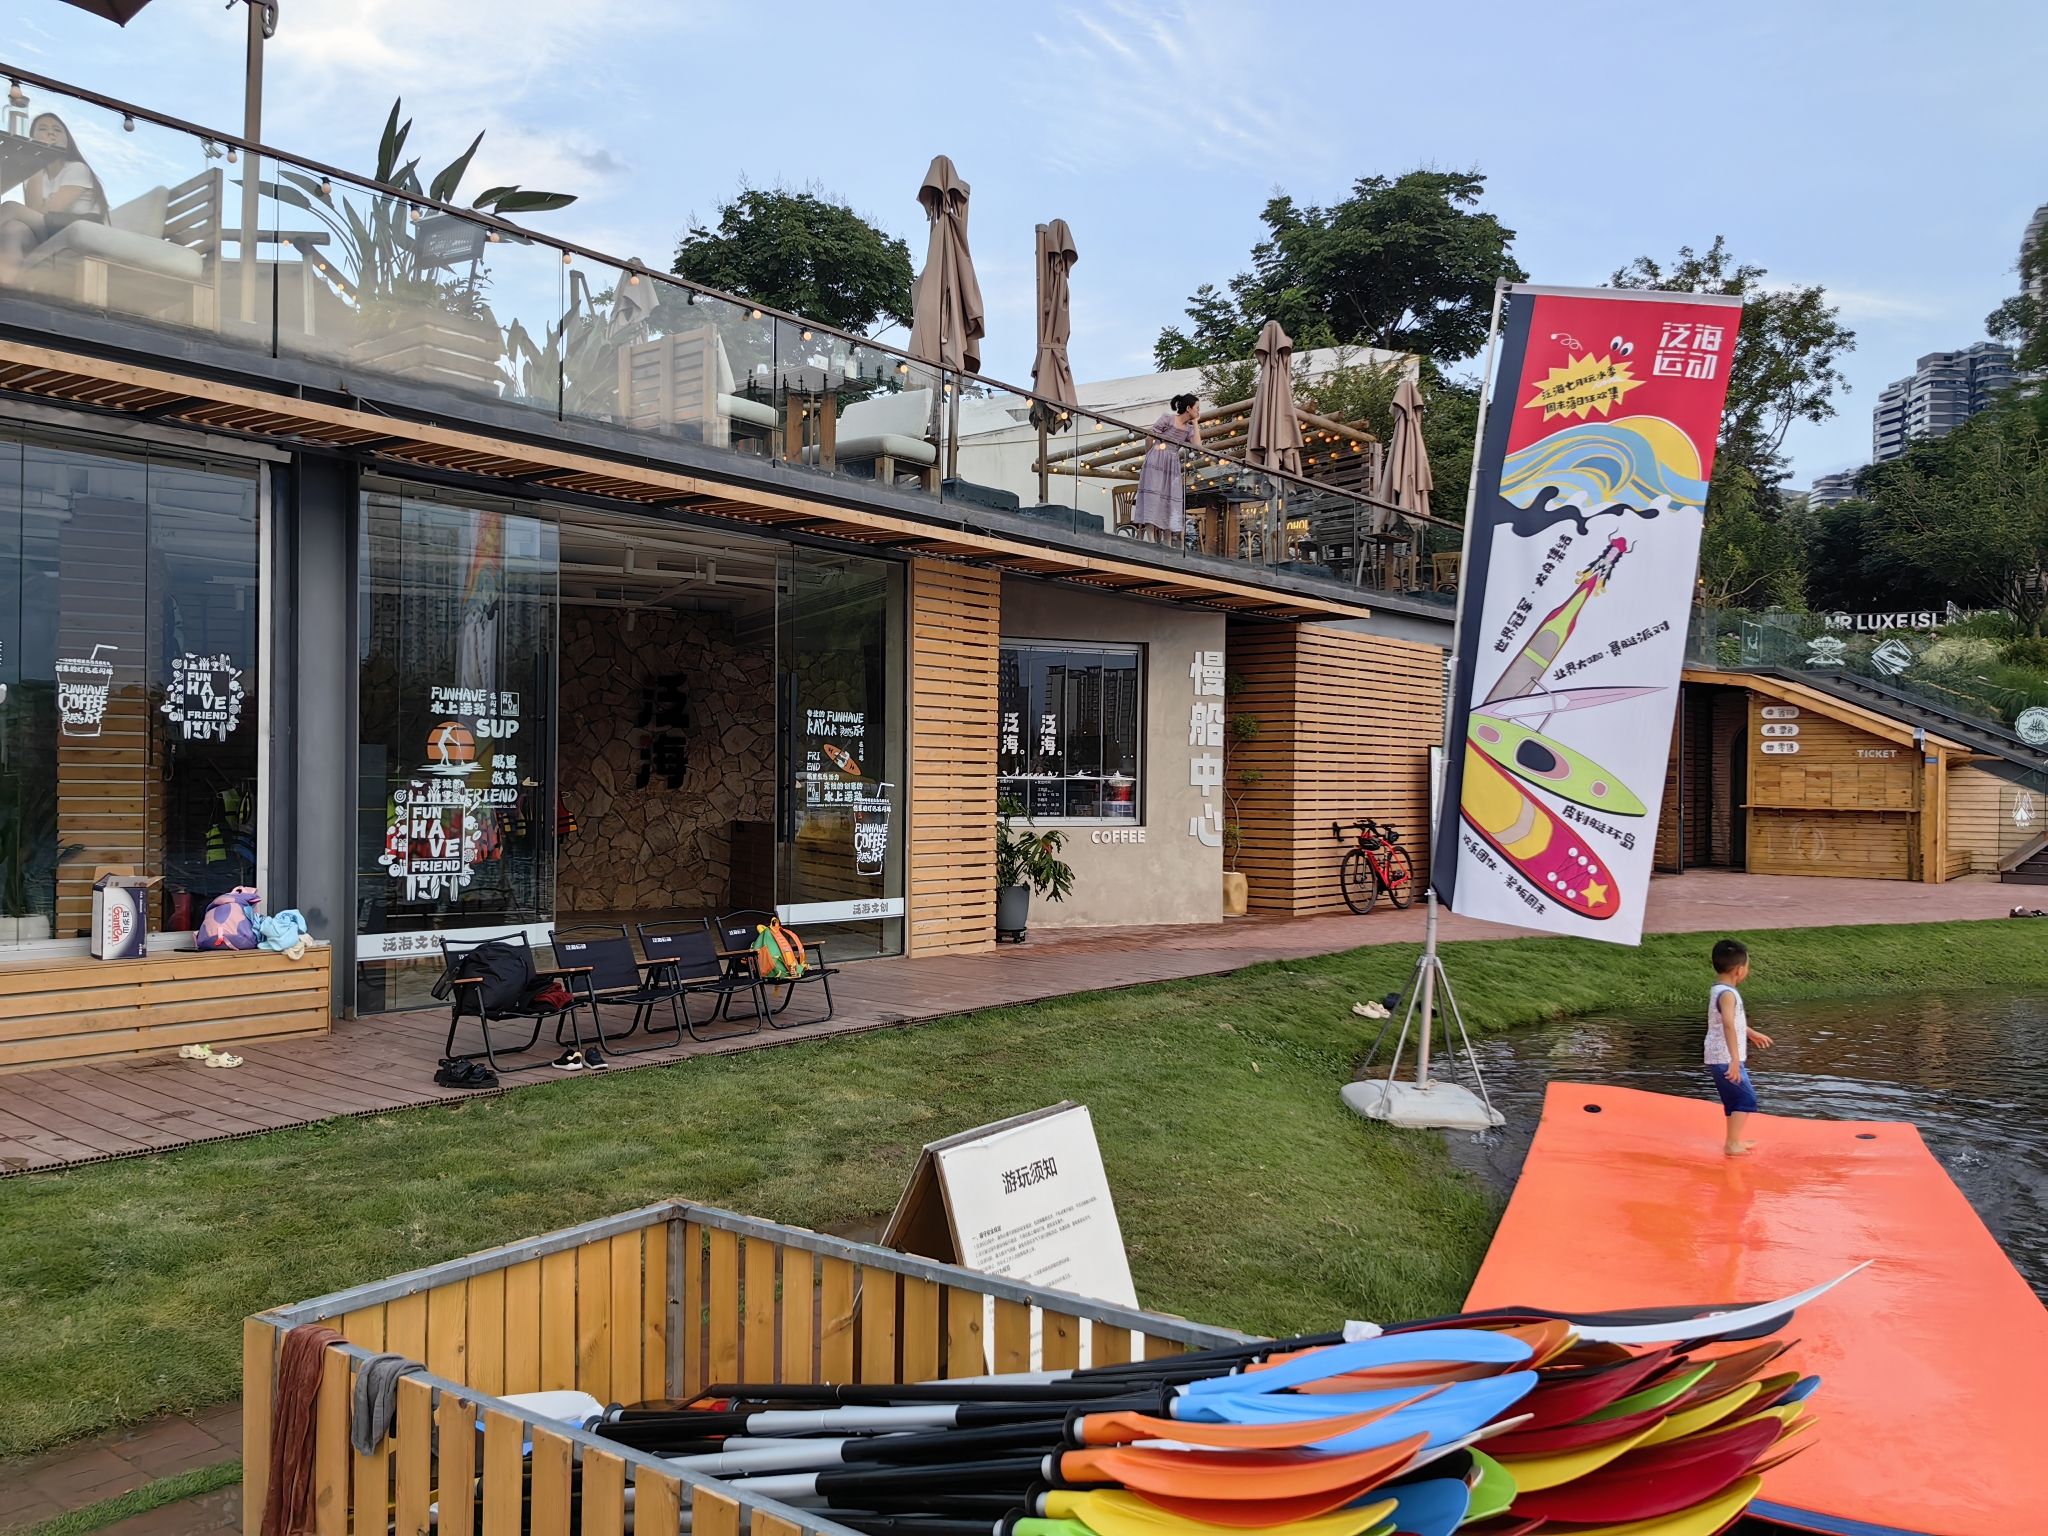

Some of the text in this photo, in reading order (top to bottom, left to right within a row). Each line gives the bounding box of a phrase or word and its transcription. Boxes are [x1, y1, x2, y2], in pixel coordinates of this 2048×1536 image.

[1659, 322, 1725, 351] 泛海
[1652, 350, 1718, 380] 运动
[188, 672, 211, 682] FUN
[59, 683, 110, 696] FUNHAVE
[431, 686, 487, 701] FUNHAVE
[58, 693, 107, 711] COFFEE
[430, 701, 486, 716] 水上运动
[187, 711, 228, 720] FRIEND
[827, 711, 864, 723] FUNHAVE
[476, 718, 519, 739] SUP
[807, 717, 837, 736] KAYAK
[807, 751, 820, 761] FRI
[1189, 651, 1225, 847] 慢船中心
[1856, 749, 1897, 758] TICKET
[465, 788, 518, 803] FRIEND
[413, 807, 442, 819] FUN
[855, 823, 888, 833] FUNHAVE
[1562, 804, 1636, 850] 皮划艇环岛
[1091, 830, 1146, 845] COFFEE
[412, 860, 460, 872] FRIEND
[1001, 1157, 1058, 1195] 游玩须知
